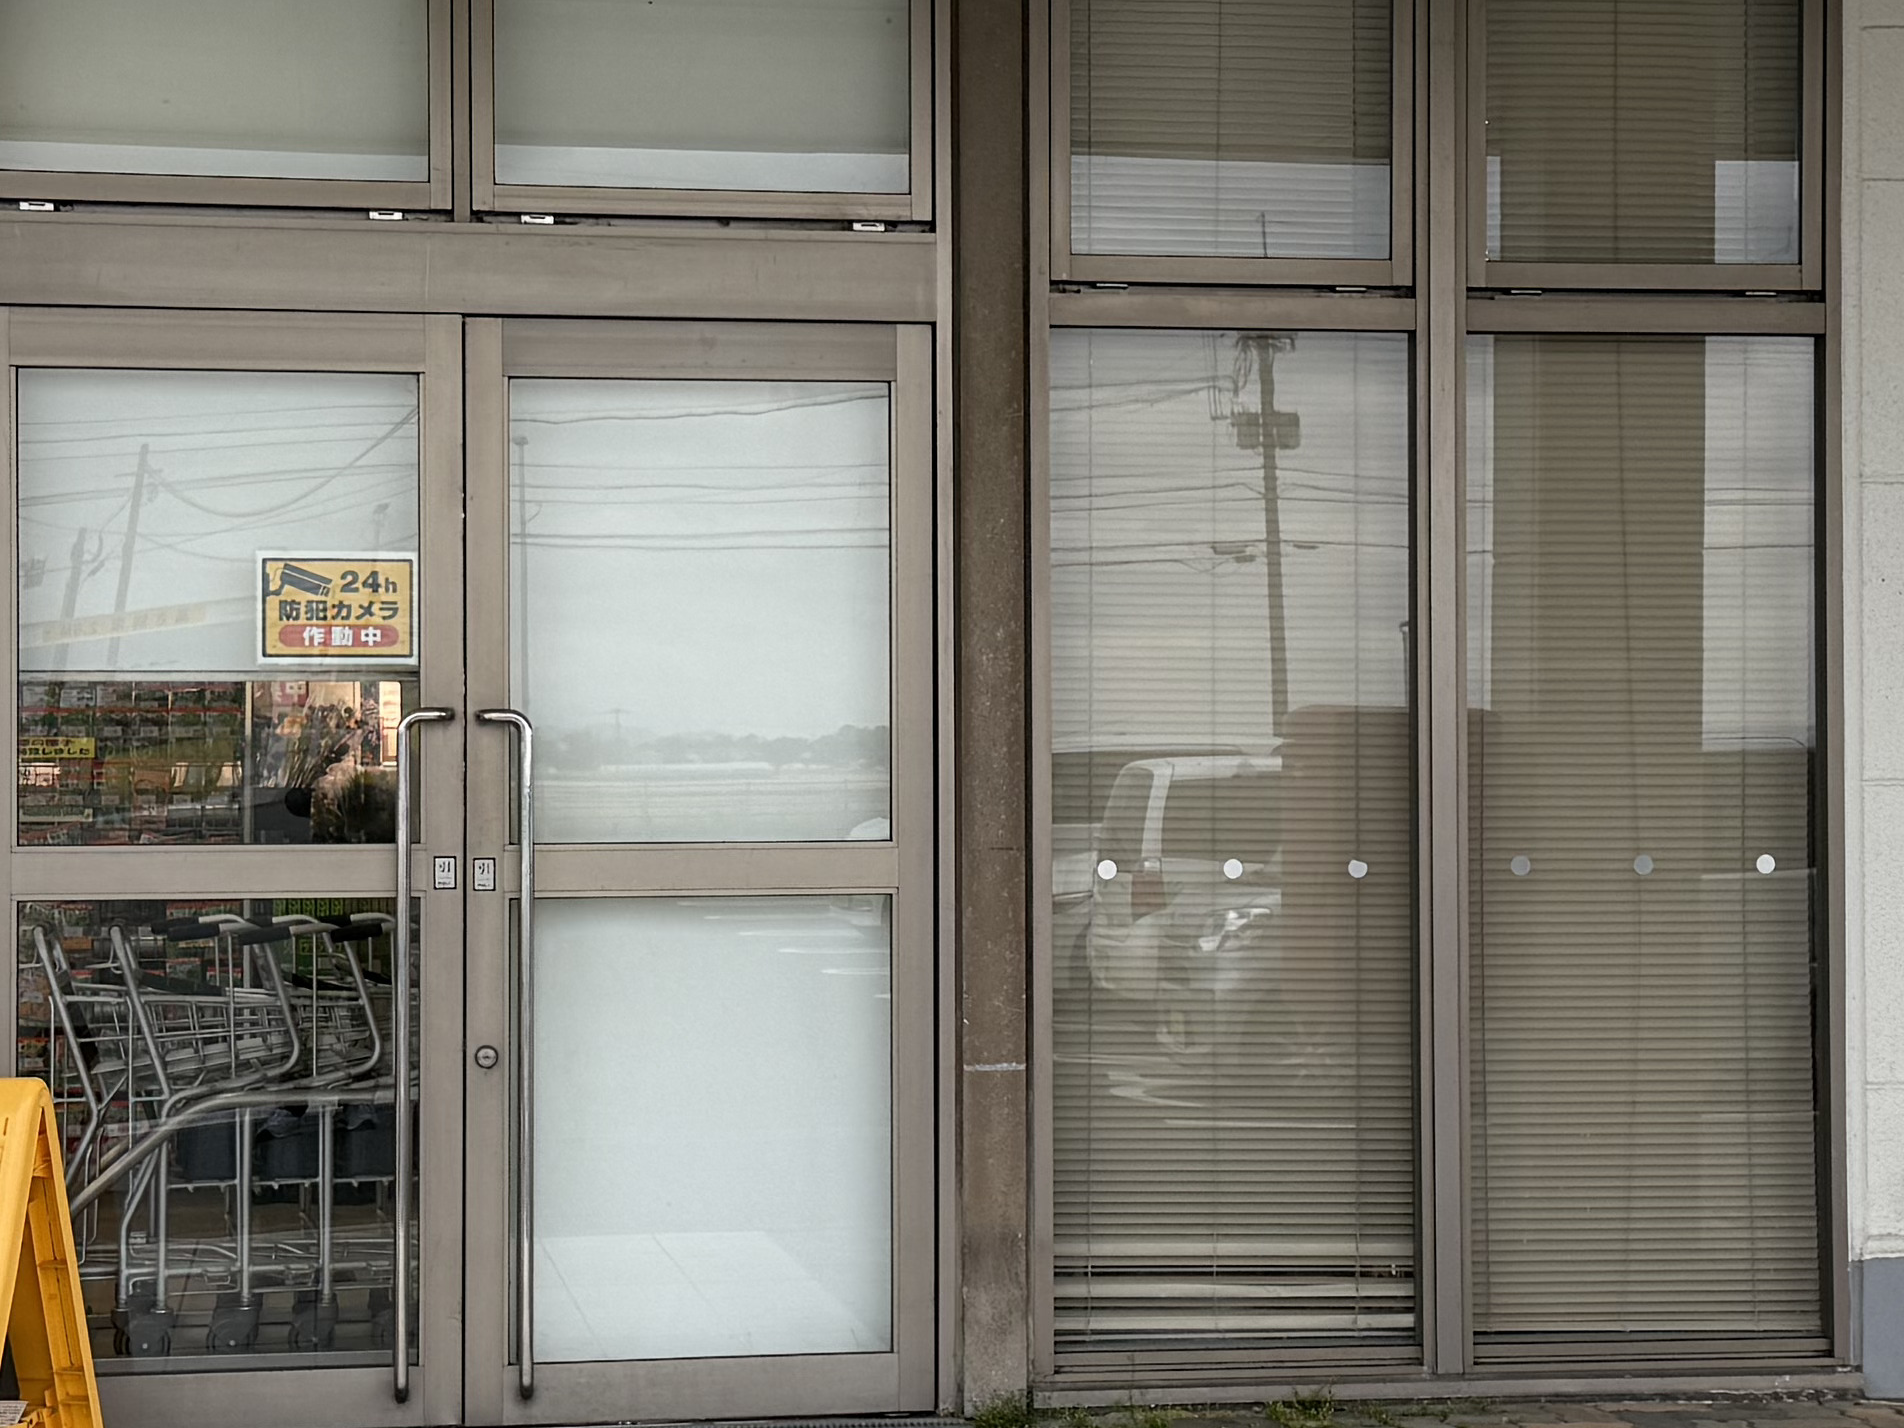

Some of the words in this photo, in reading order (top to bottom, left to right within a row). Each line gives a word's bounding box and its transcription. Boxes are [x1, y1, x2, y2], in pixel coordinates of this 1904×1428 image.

[340, 570, 398, 593] 24h
[278, 599, 400, 622] 防犯カメラ
[302, 626, 382, 647] 作動中
